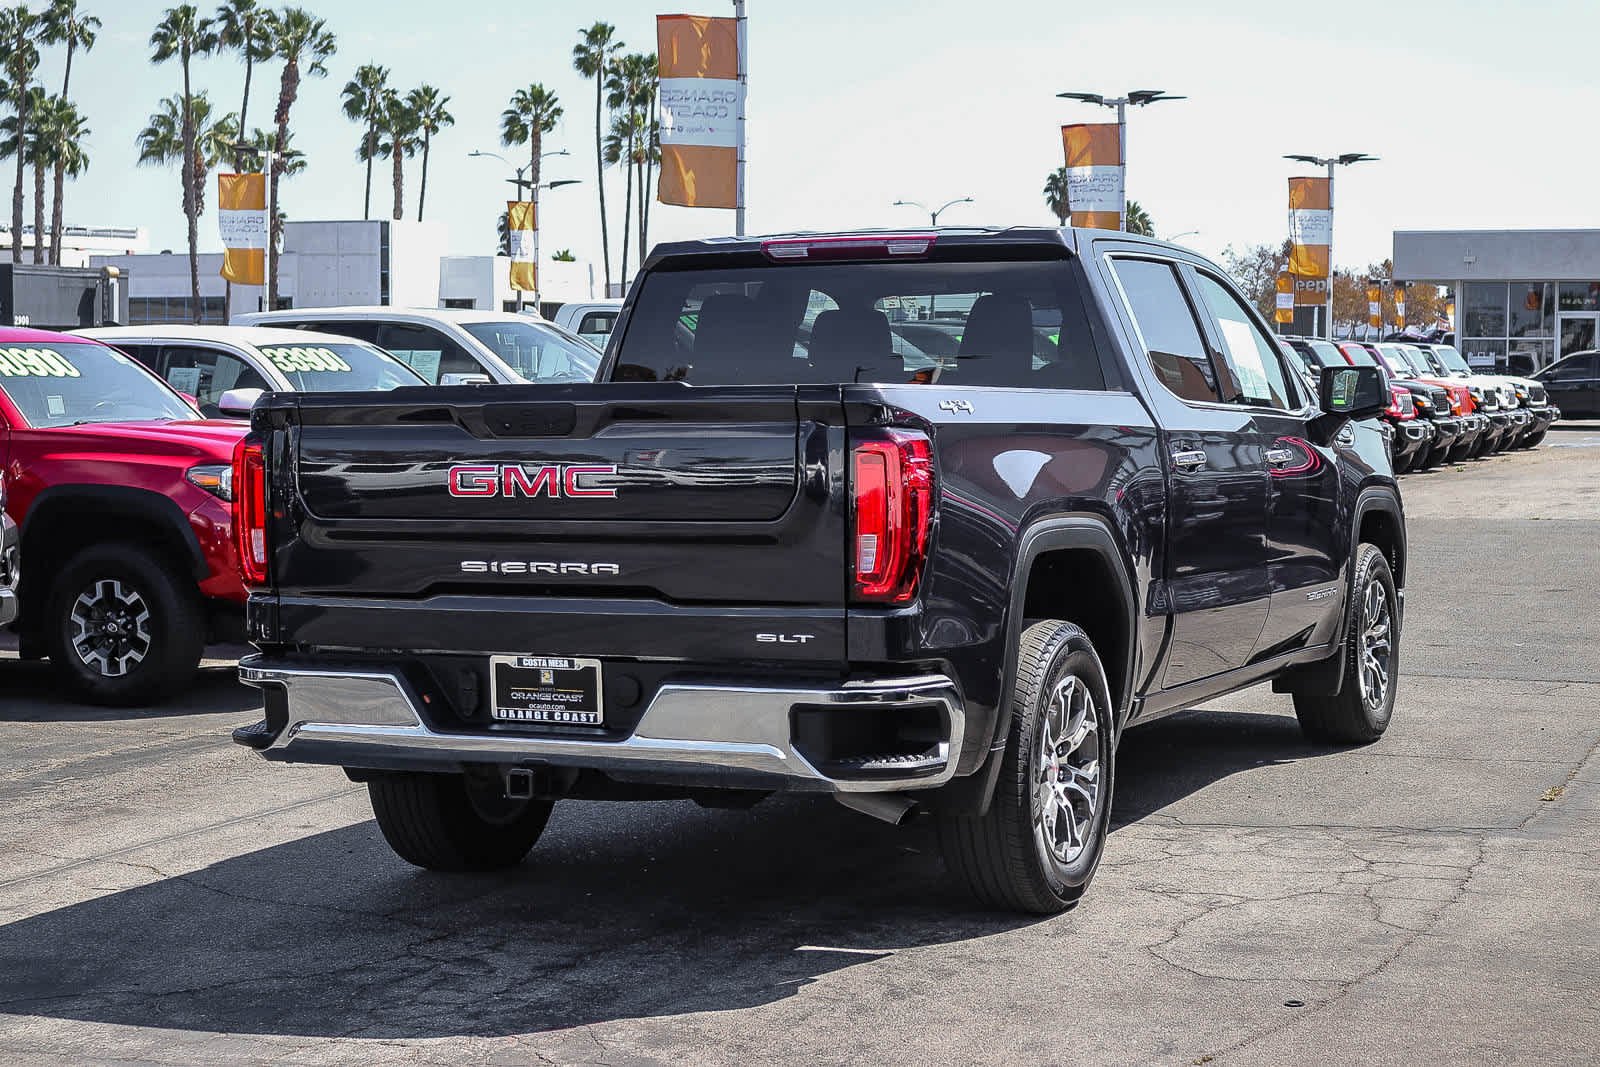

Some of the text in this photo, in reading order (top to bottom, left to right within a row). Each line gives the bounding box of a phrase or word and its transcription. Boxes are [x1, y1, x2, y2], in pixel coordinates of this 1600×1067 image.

[1295, 280, 1327, 292] eep
[261, 347, 353, 373] 33900
[448, 464, 619, 499] GMC
[460, 560, 621, 576] SIERRA
[756, 633, 816, 644] SLT
[523, 657, 569, 668] COSTA MESA
[511, 692, 584, 703] ORANGE COAST
[500, 709, 596, 723] ORANGE COAST
